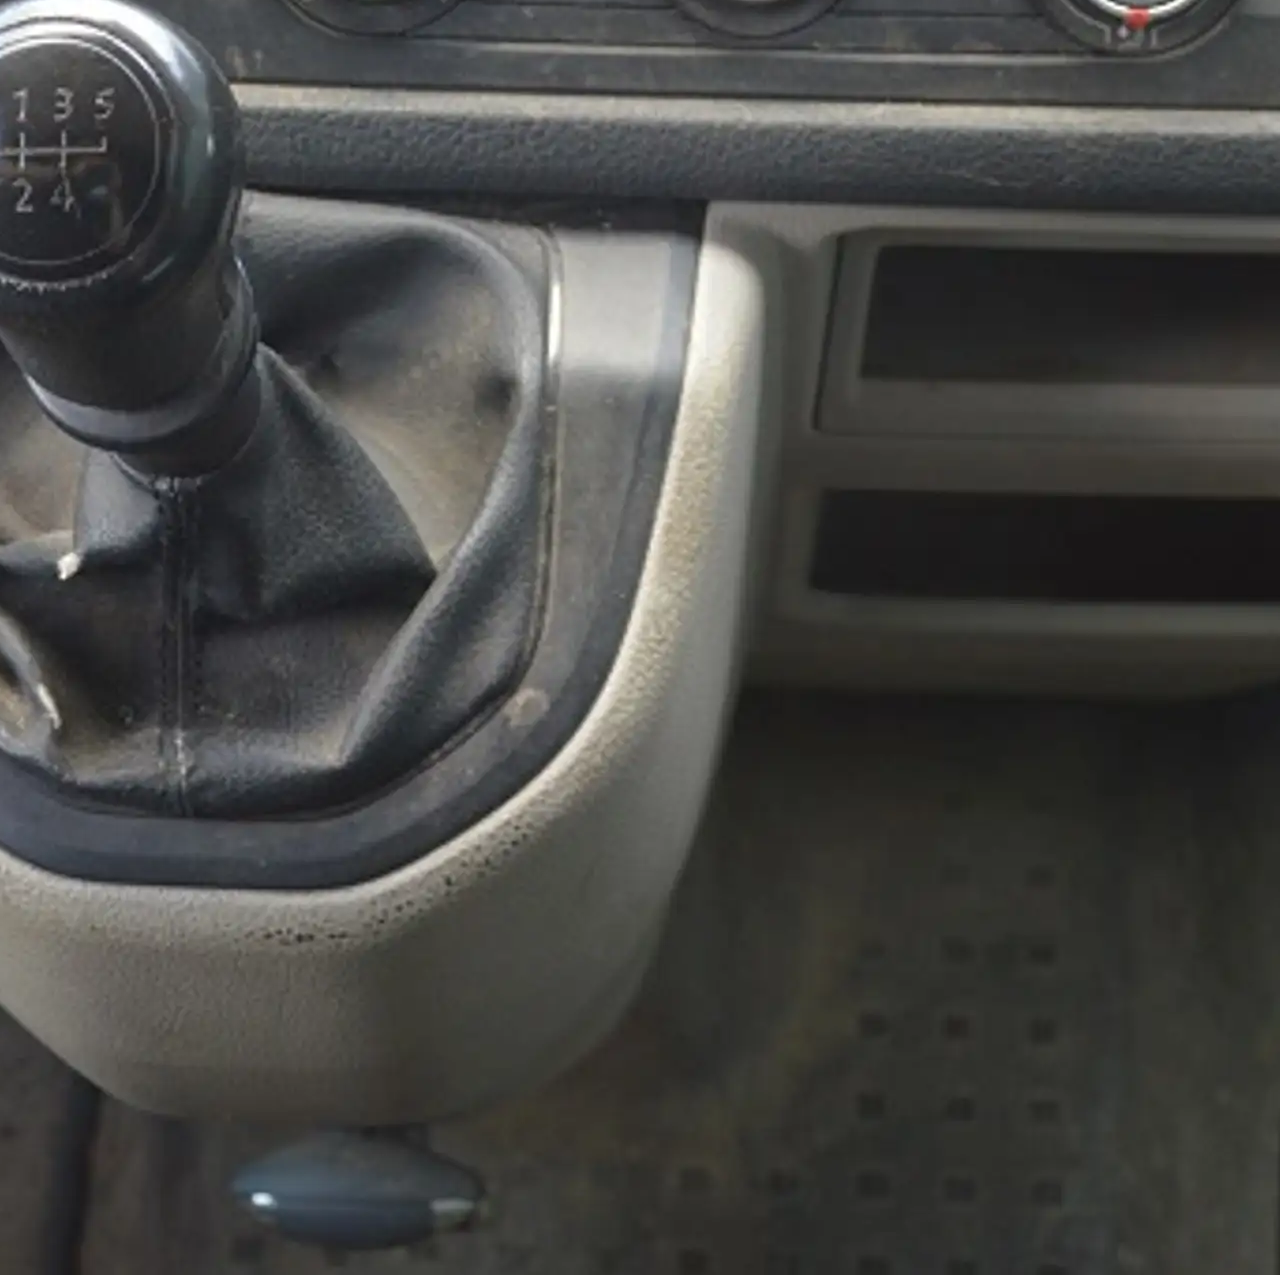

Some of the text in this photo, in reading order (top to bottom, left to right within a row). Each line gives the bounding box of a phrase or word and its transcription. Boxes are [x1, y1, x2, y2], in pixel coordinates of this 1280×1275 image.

[14, 90, 28, 122] 1
[54, 88, 73, 122] 3
[94, 87, 115, 120] 5
[14, 178, 74, 213] 2 4
